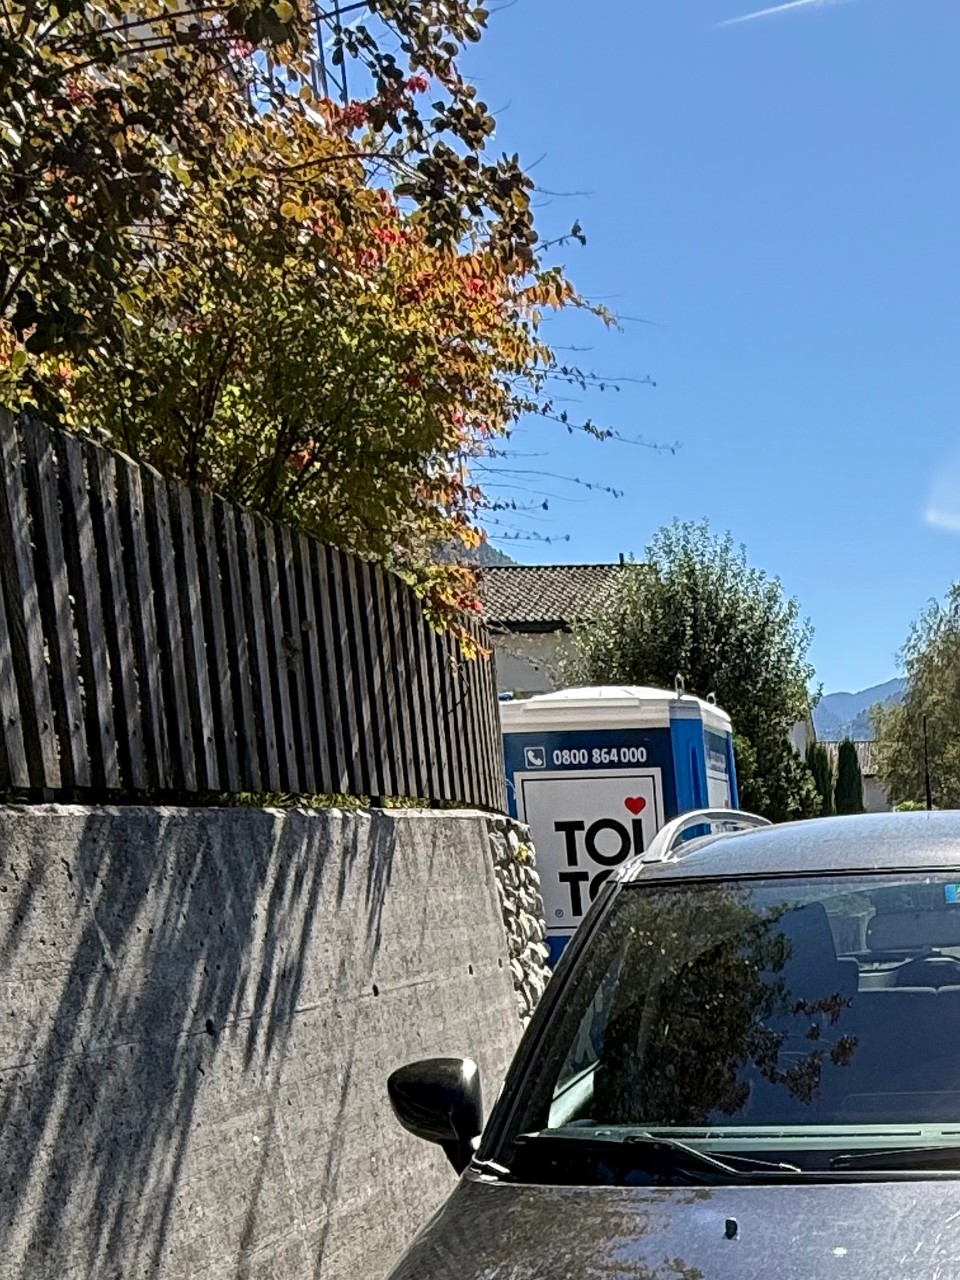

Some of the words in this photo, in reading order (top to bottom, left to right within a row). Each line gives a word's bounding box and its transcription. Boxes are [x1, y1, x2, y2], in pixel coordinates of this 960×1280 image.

[553, 749, 589, 766] 0800
[592, 748, 619, 765] 864
[620, 747, 648, 764] 000
